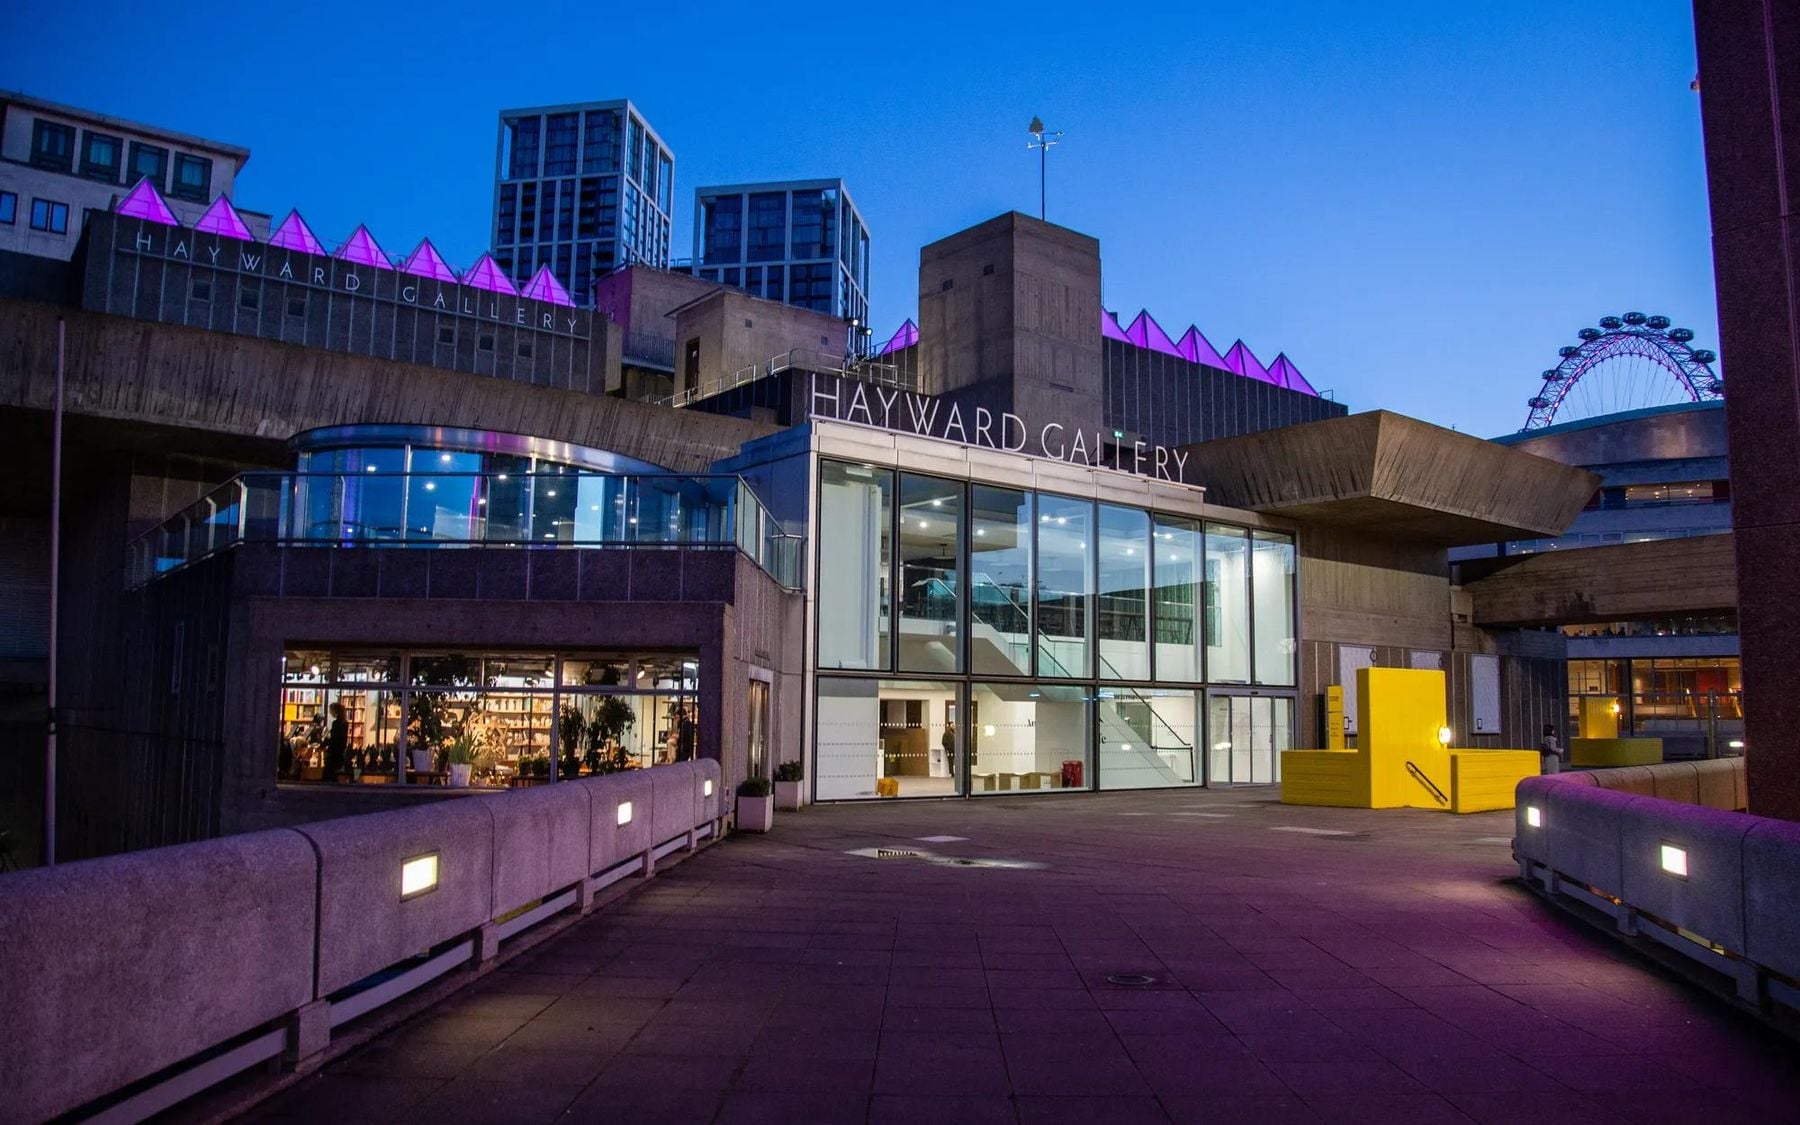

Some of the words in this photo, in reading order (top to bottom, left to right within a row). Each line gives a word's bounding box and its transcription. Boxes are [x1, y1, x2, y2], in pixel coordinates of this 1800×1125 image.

[136, 232, 361, 291] HAYWARD
[402, 286, 577, 333] GALLERY
[811, 373, 1027, 452] HAYWARD
[1041, 423, 1188, 483] GALLERY
